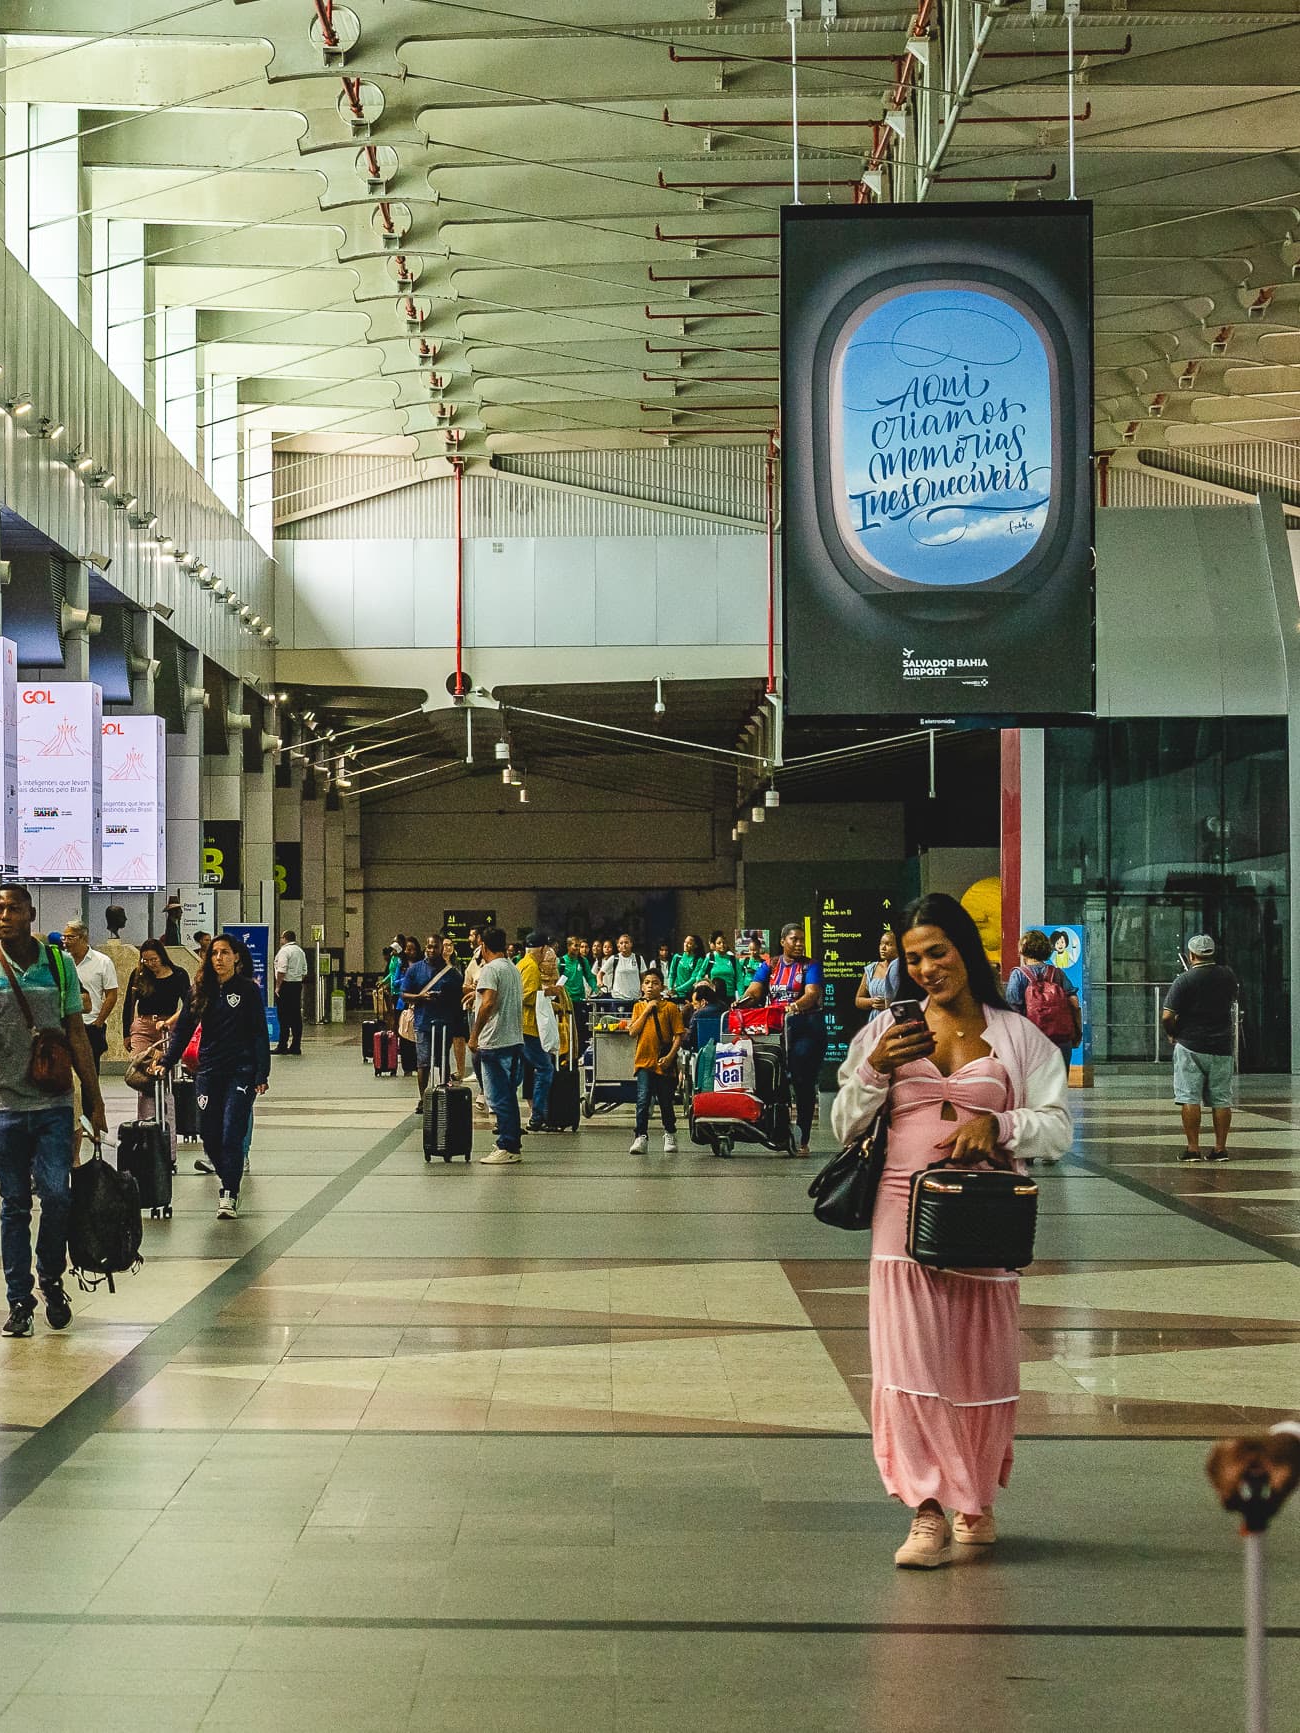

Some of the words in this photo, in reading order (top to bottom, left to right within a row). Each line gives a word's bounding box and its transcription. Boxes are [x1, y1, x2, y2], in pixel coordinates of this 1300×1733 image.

[902, 659, 954, 667] SALVADOR
[902, 668, 948, 676] AIRPORT
[22, 690, 55, 704] GOL
[198, 902, 206, 915] 1
